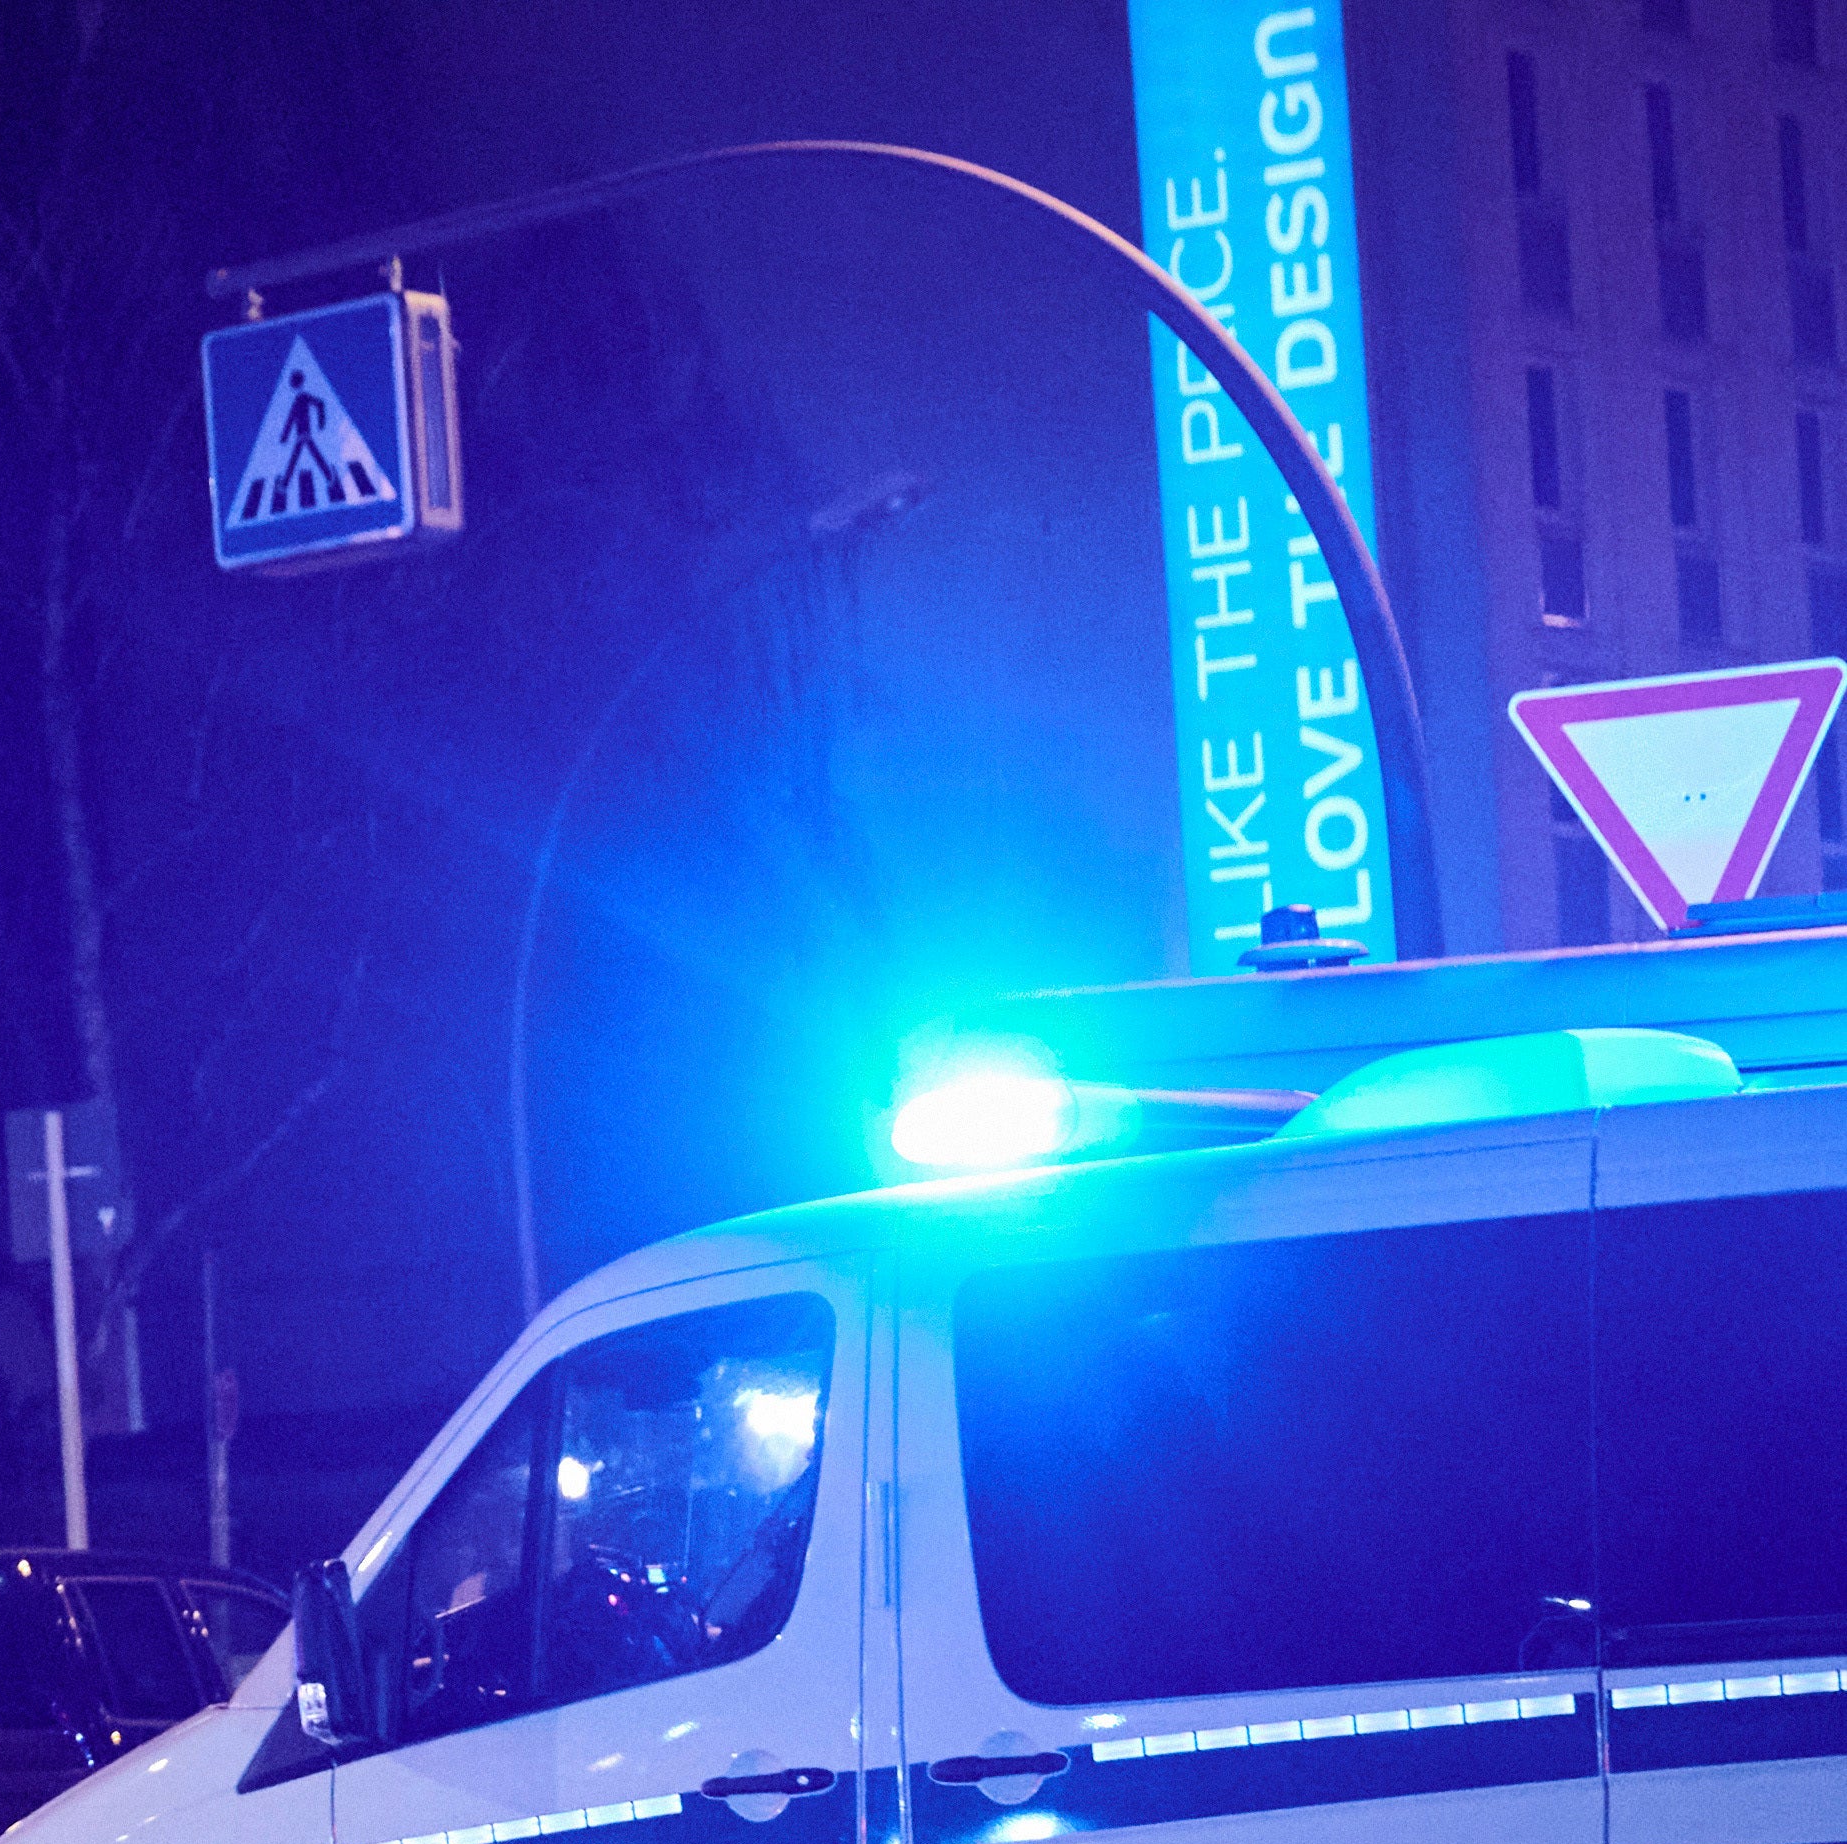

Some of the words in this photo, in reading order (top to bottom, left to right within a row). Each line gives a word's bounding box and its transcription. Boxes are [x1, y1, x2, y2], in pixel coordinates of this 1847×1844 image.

[1186, 495, 1257, 701] THE
[1202, 731, 1273, 940] LIKE
[1296, 658, 1372, 929] LOVE
